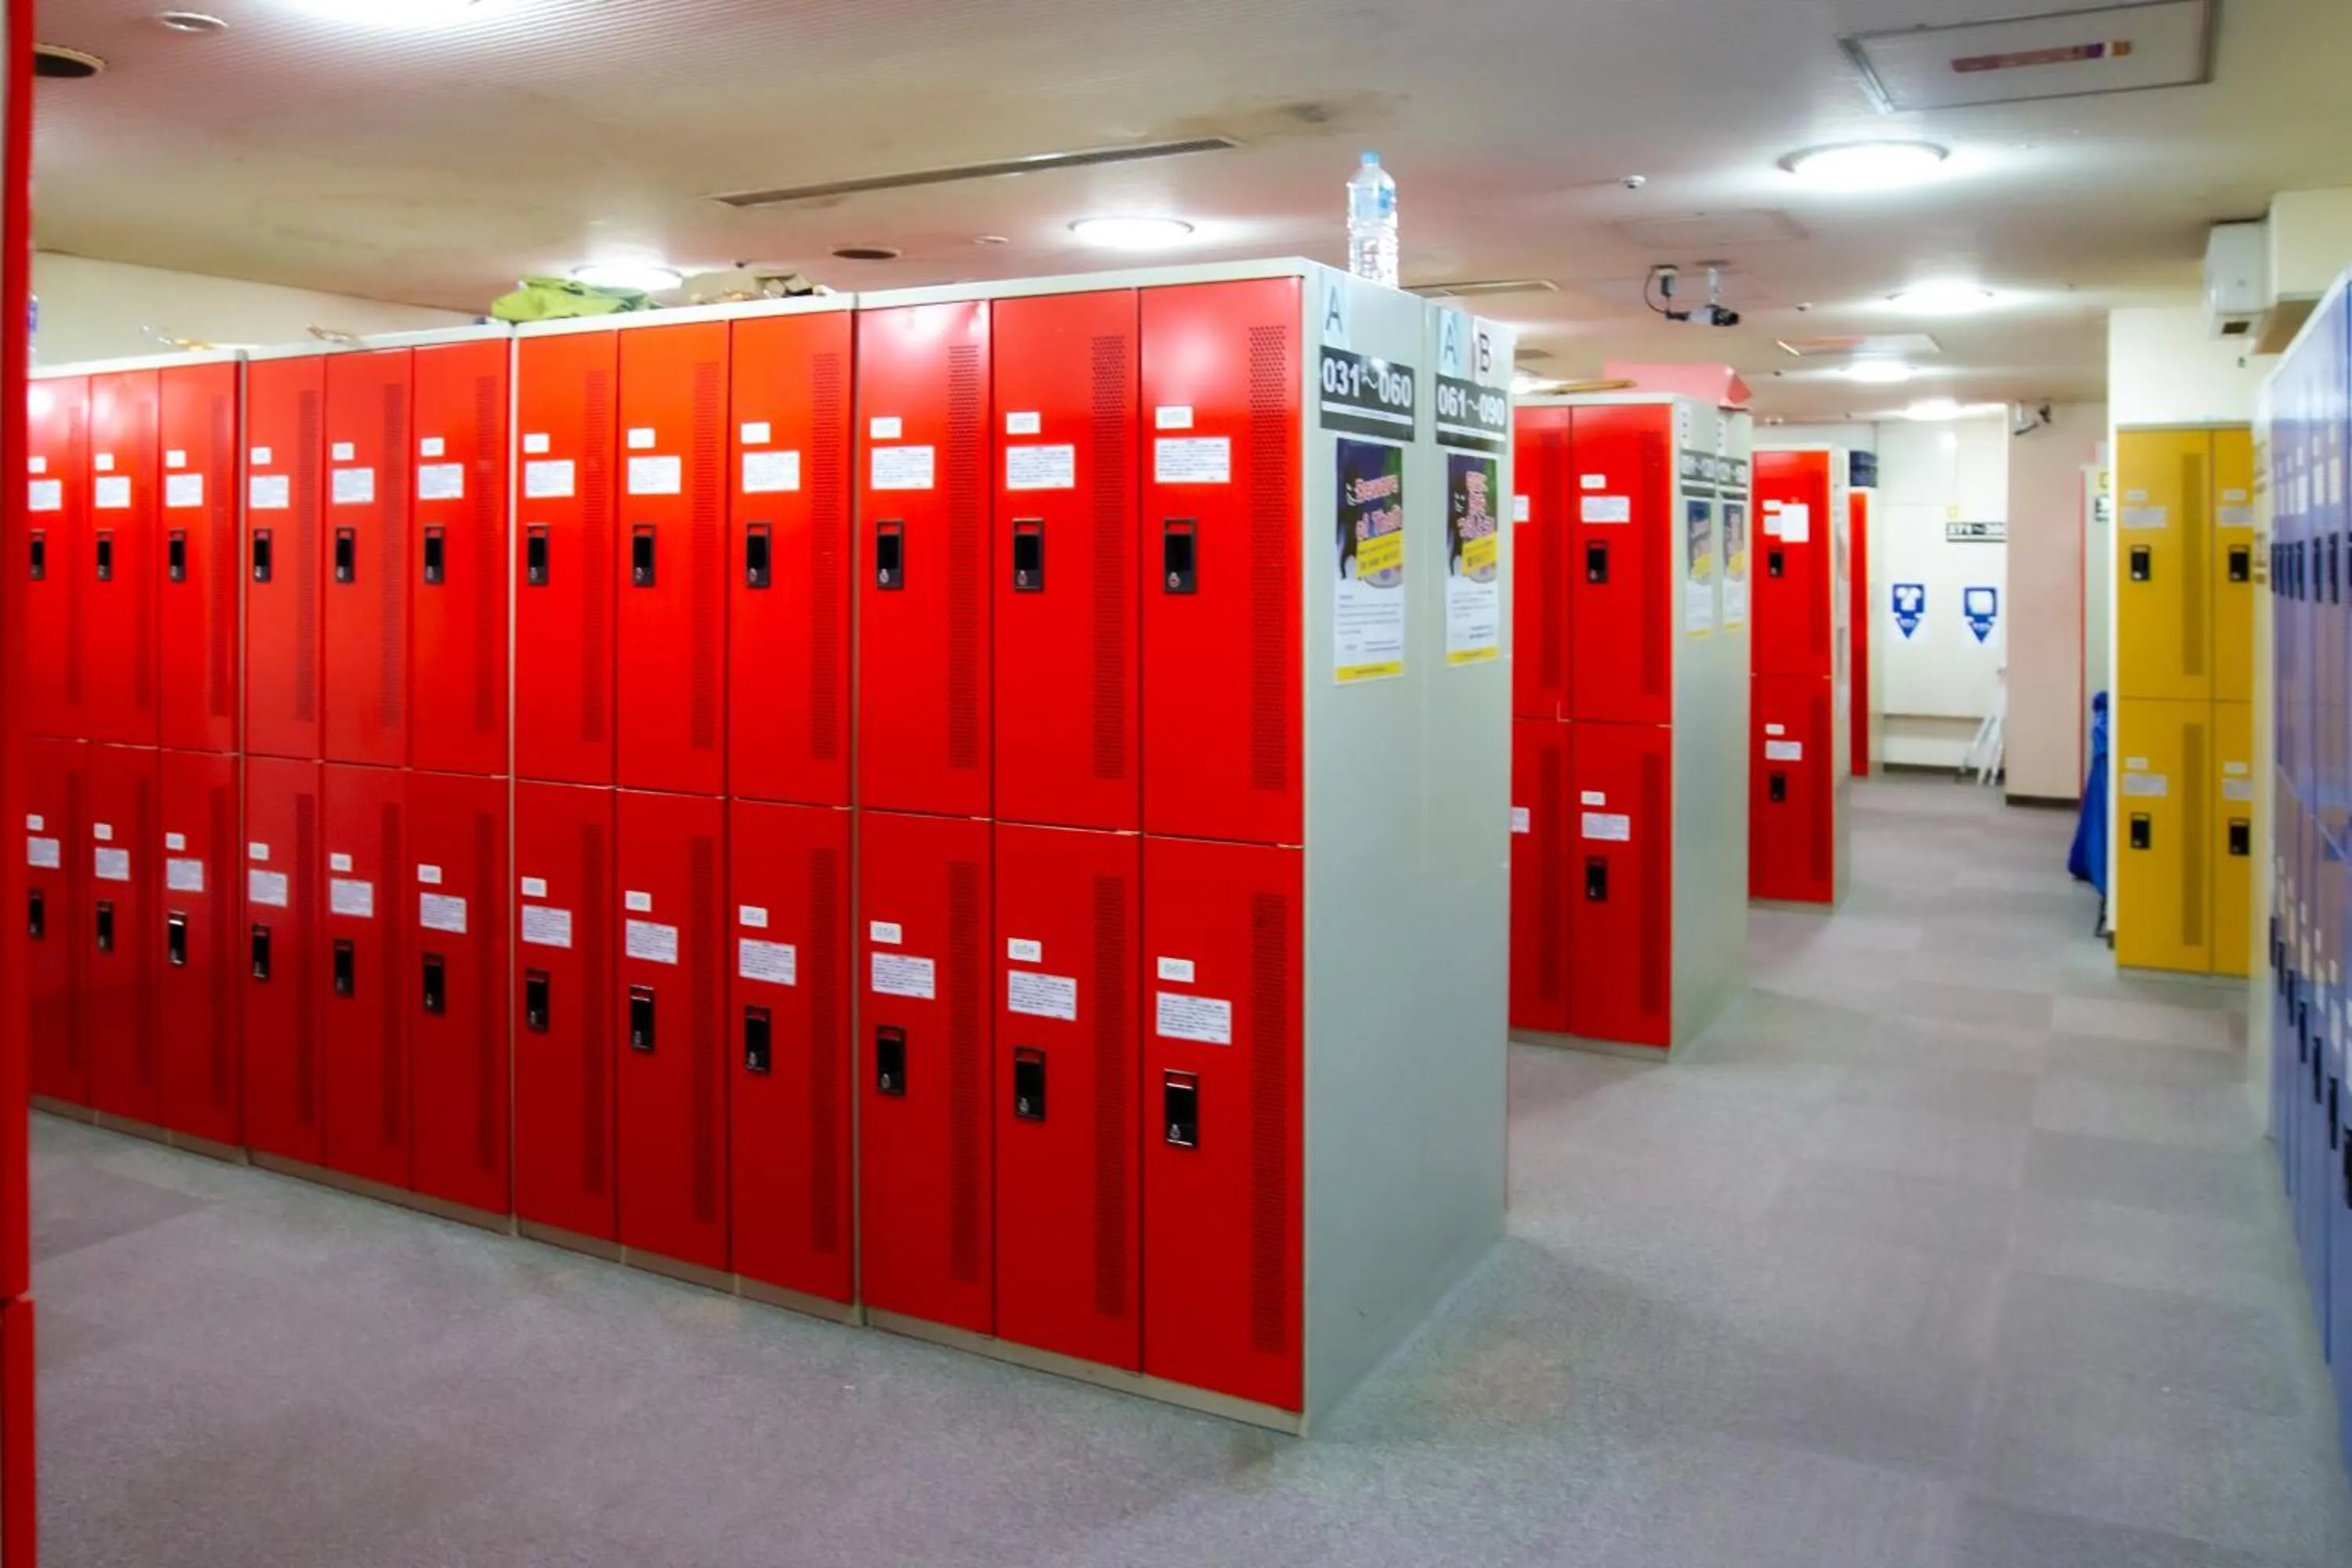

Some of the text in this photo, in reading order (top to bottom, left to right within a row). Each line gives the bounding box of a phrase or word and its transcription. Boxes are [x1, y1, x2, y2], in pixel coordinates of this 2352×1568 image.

[1325, 285, 1343, 332] A
[1443, 321, 1457, 365] A
[1479, 332, 1491, 372] B
